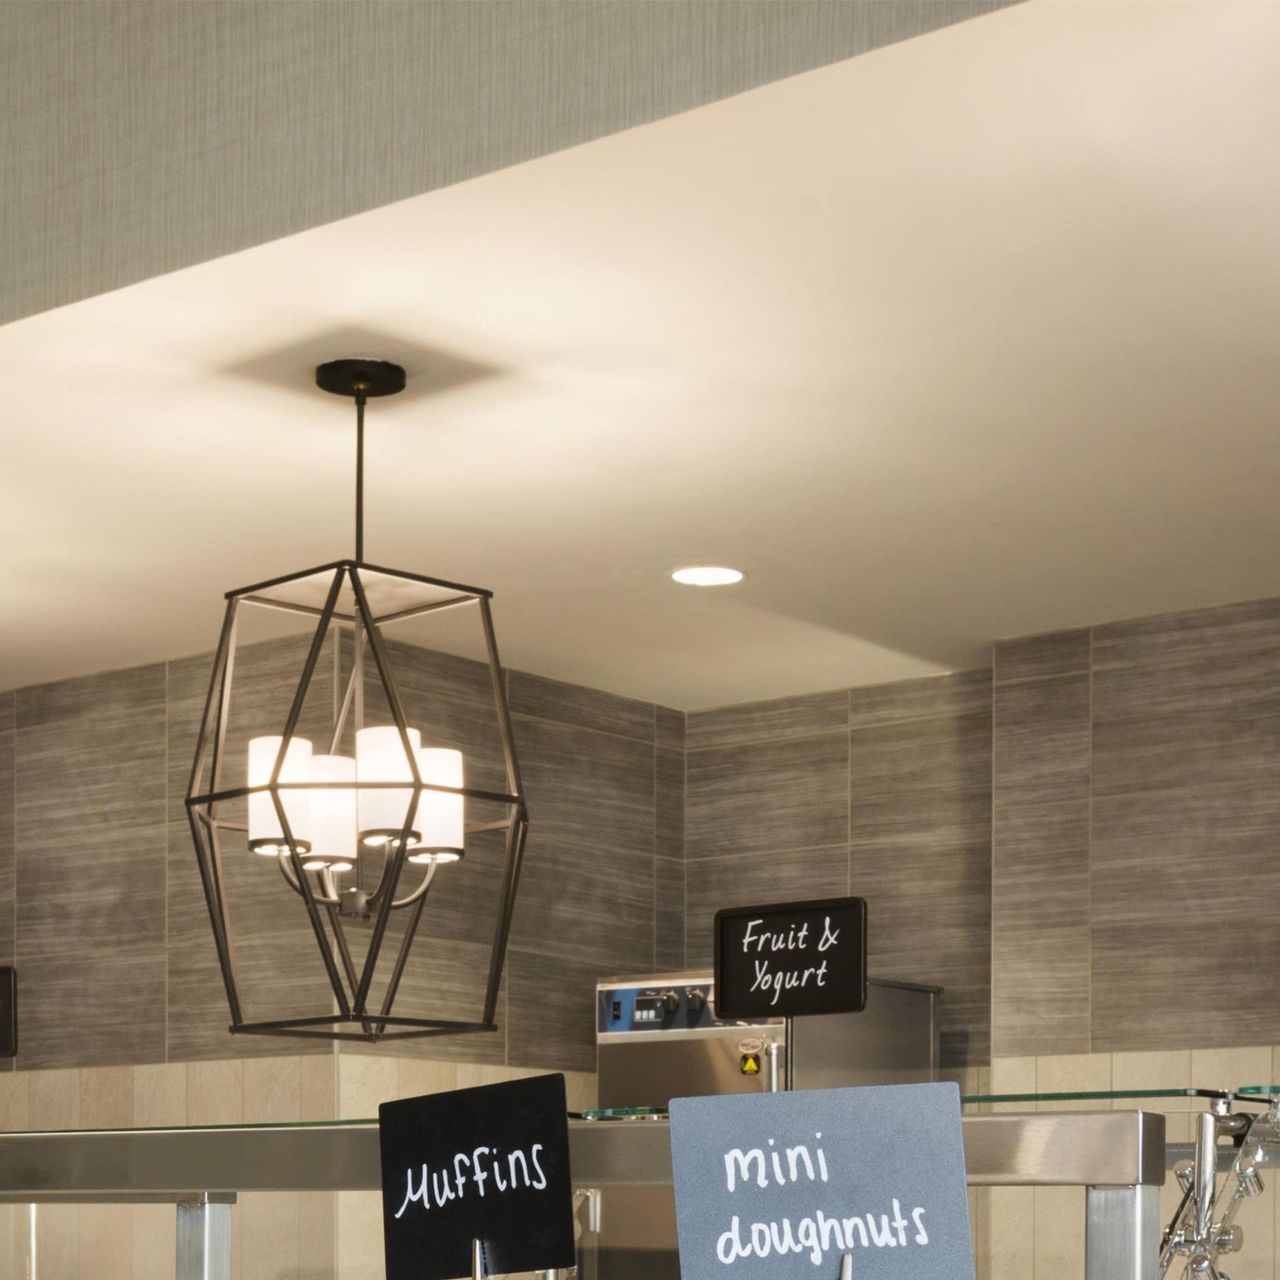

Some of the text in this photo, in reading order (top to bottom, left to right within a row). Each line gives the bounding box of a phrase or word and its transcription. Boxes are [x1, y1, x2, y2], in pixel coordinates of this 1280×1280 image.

[741, 916, 840, 953] Fruit &
[749, 959, 828, 1006] Yogurt
[393, 1143, 549, 1219] Muffins
[723, 1132, 830, 1193] mini
[716, 1198, 930, 1266] doughnuts
